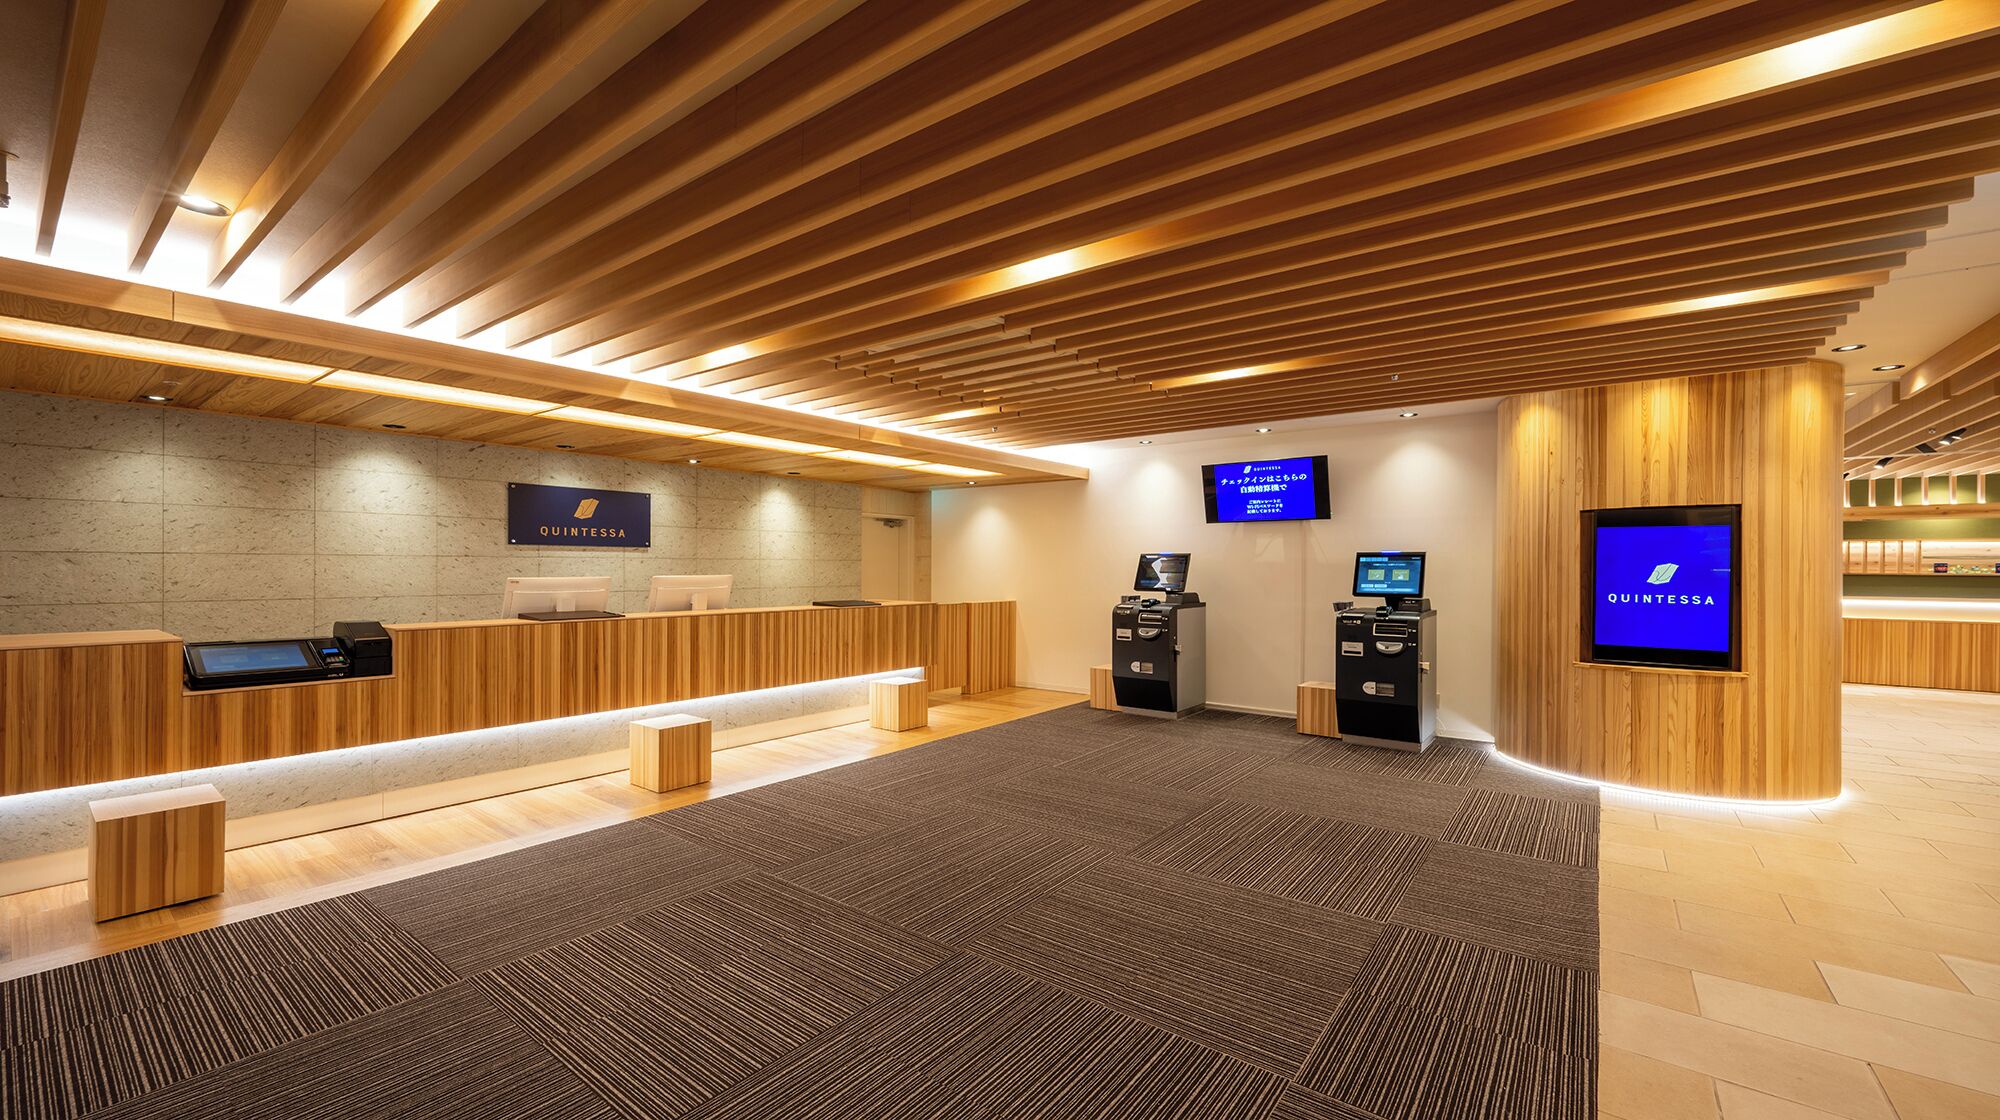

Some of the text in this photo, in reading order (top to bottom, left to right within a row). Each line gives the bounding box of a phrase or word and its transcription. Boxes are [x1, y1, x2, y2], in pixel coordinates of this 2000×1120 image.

[1221, 473, 1307, 486] チェックインはこちらの
[1240, 484, 1287, 494] 自動精算機で
[540, 526, 625, 538] QUINTESSA
[1608, 593, 1715, 605] QUINTESSA
